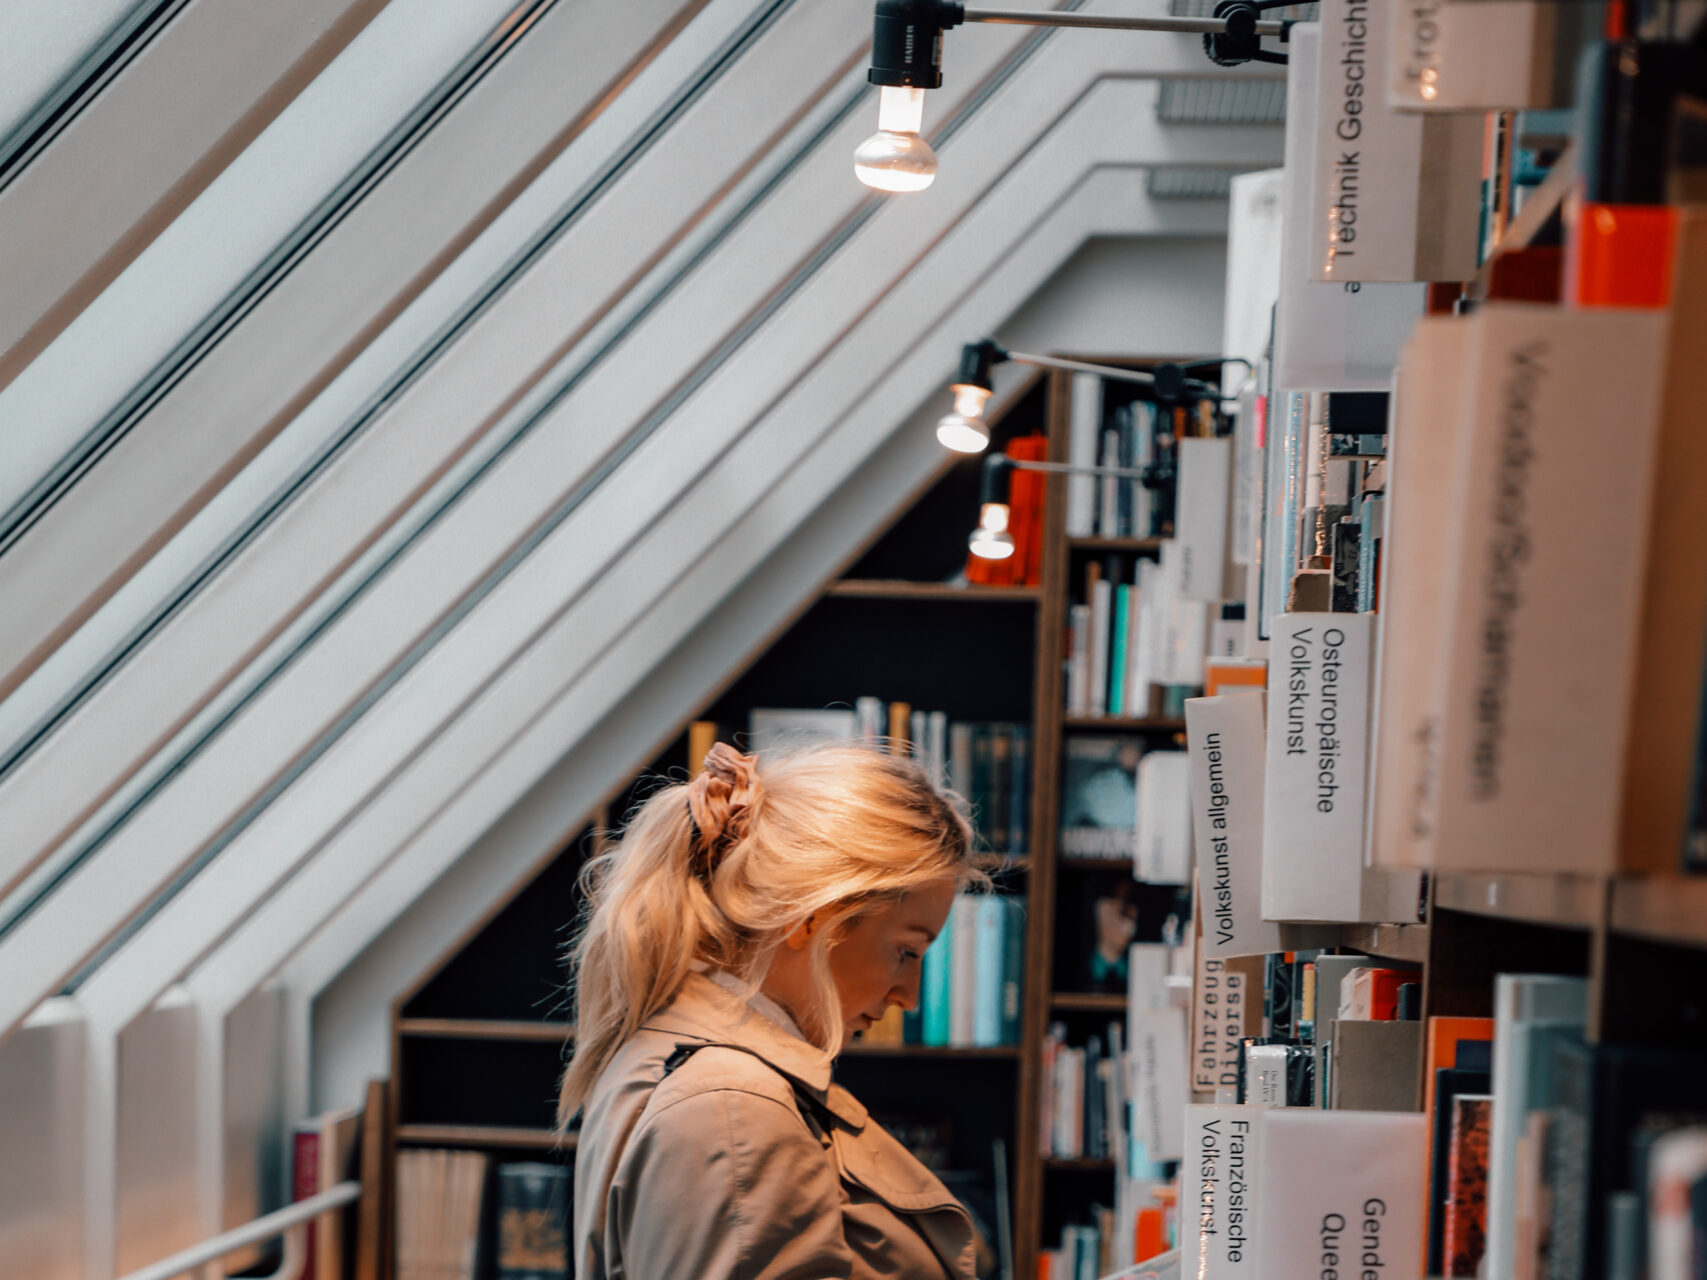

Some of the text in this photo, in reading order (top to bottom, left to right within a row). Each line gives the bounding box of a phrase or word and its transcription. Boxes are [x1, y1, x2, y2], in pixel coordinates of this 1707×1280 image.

[1332, 151, 1361, 260] Technik
[1286, 627, 1313, 756] Volkskunst
[1315, 627, 1346, 814] Osteuropäische
[1203, 732, 1235, 946] Volkskunst allgemein
[1196, 959, 1224, 1087] Fahrzeug
[1219, 974, 1242, 1086] Diverse
[1200, 1119, 1222, 1237] Volkskunst
[1227, 1120, 1249, 1263] Französische
